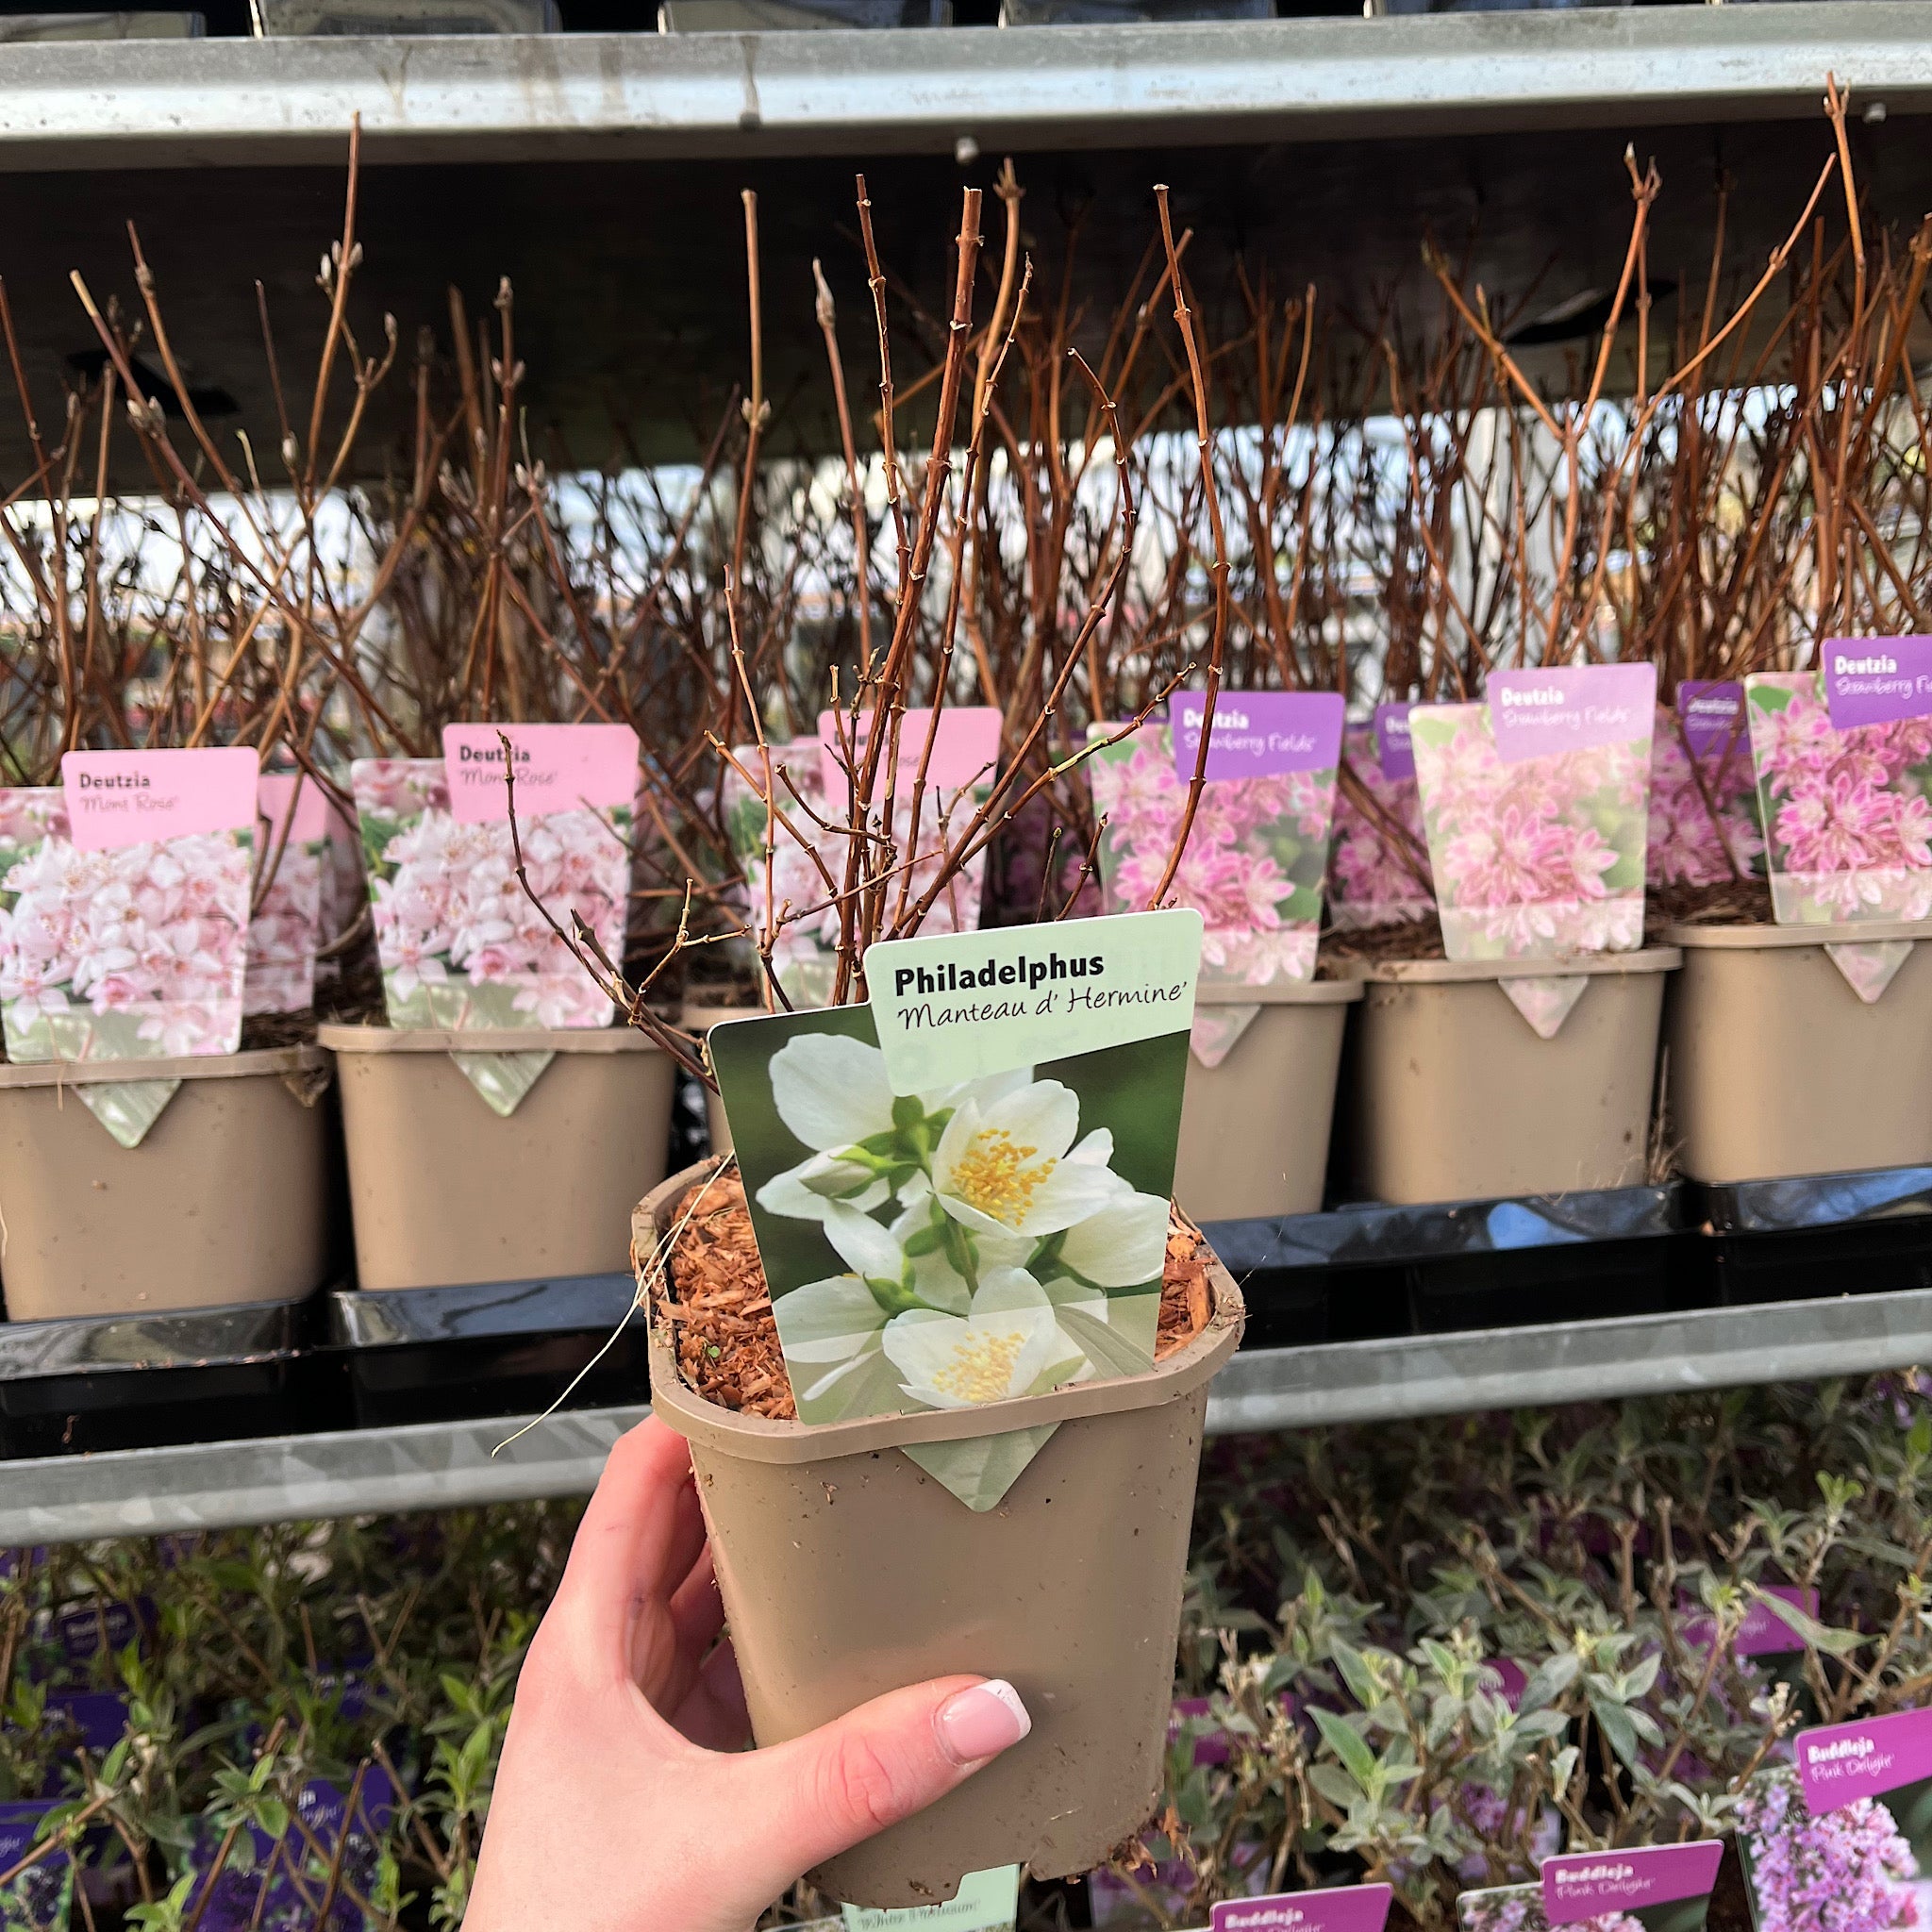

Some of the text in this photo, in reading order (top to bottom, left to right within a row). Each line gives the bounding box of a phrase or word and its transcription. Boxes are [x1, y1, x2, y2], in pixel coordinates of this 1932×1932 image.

[1834, 654, 1897, 675] Deutzia
[1501, 686, 1564, 707] Deutzia
[459, 744, 531, 761] Deutia
[79, 771, 151, 789] Deutzia
[895, 953, 1105, 996] Philadelphus
[1067, 981, 1188, 1013] Hermine'
[1807, 1736, 1875, 1764] Buddleja
[1555, 1863, 1634, 1884] Buddleja
[1224, 1907, 1304, 1929] Buddleja
